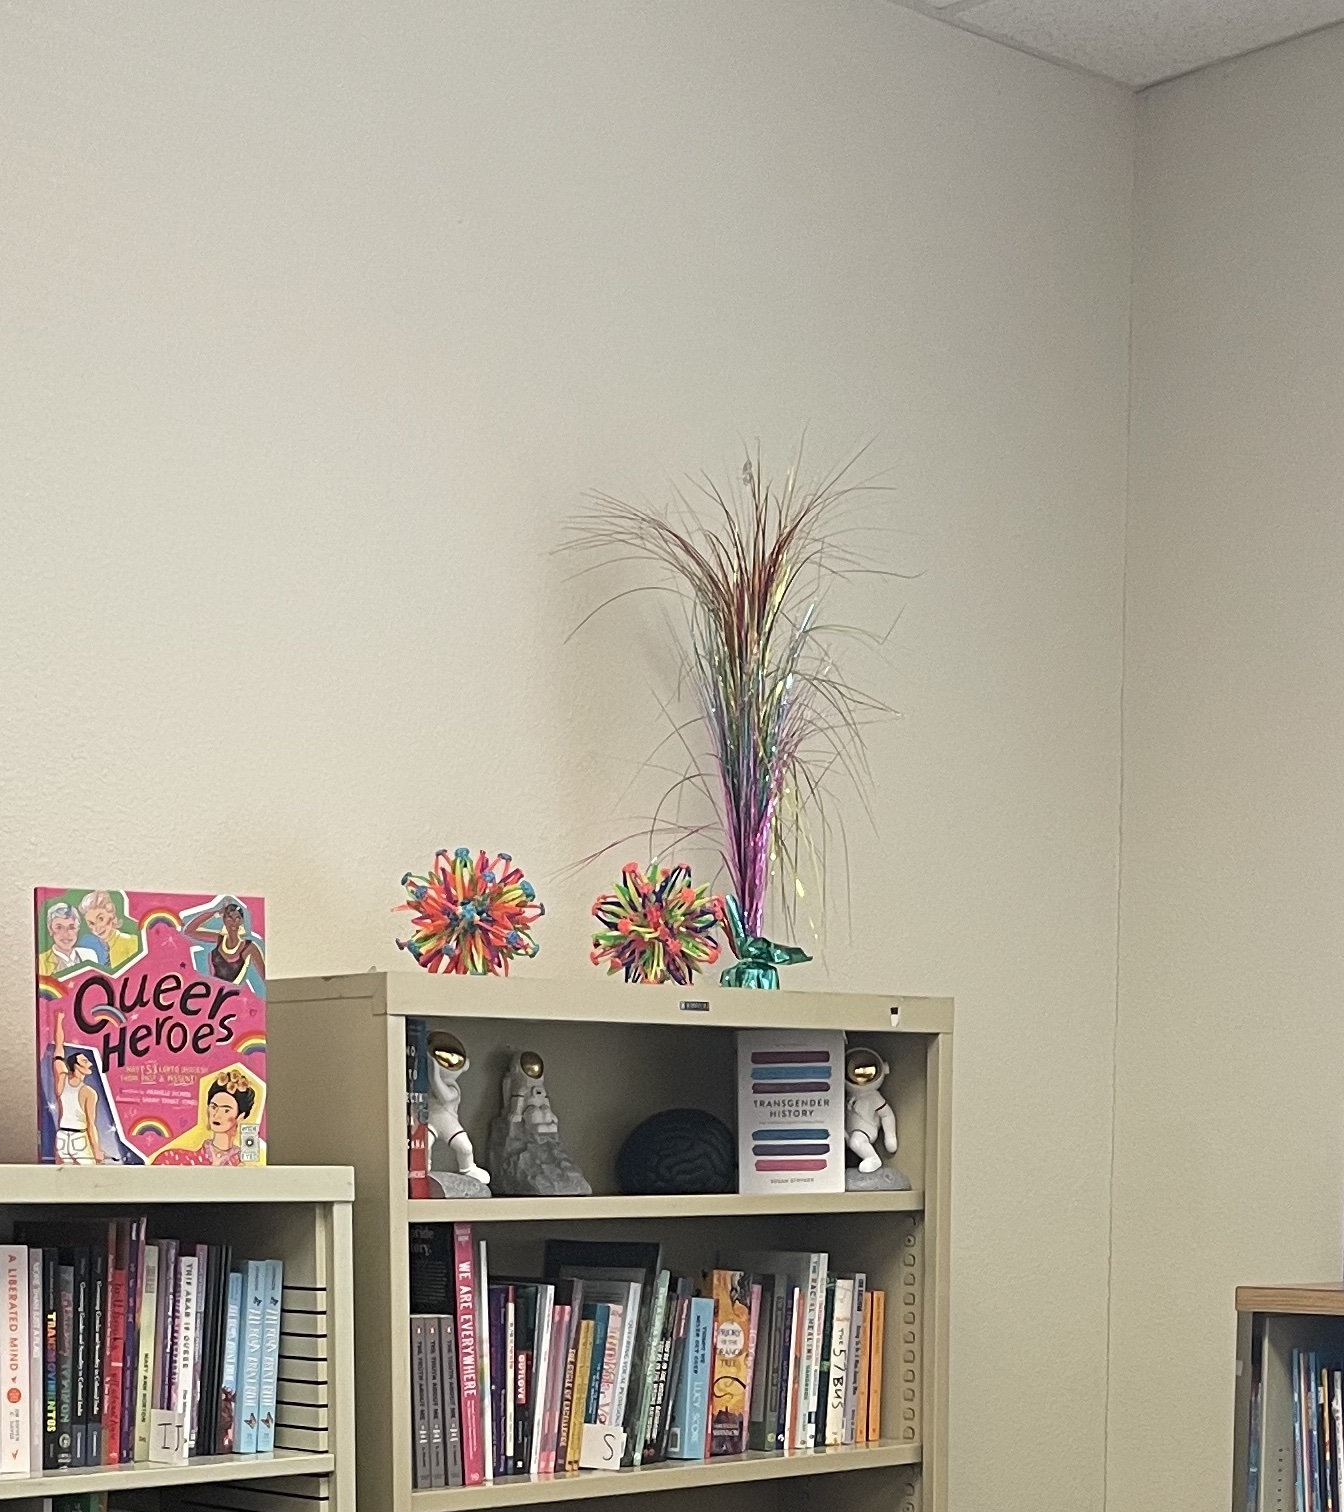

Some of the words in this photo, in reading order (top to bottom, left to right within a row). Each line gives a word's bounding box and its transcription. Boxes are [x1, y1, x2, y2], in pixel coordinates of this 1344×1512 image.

[74, 974, 240, 1035] Queer
[102, 1013, 237, 1073] Heroes
[753, 1099, 830, 1108] TRANSGENDER
[770, 1109, 814, 1118] HISTORY
[8, 1254, 17, 1263] A
[458, 1261, 471, 1280] WE
[8, 1267, 18, 1332] LIBERATED
[459, 1286, 472, 1310] ARE
[9, 1336, 18, 1371] MIND
[461, 1315, 477, 1397] EVERYWHERE
[603, 1433, 616, 1461] S
